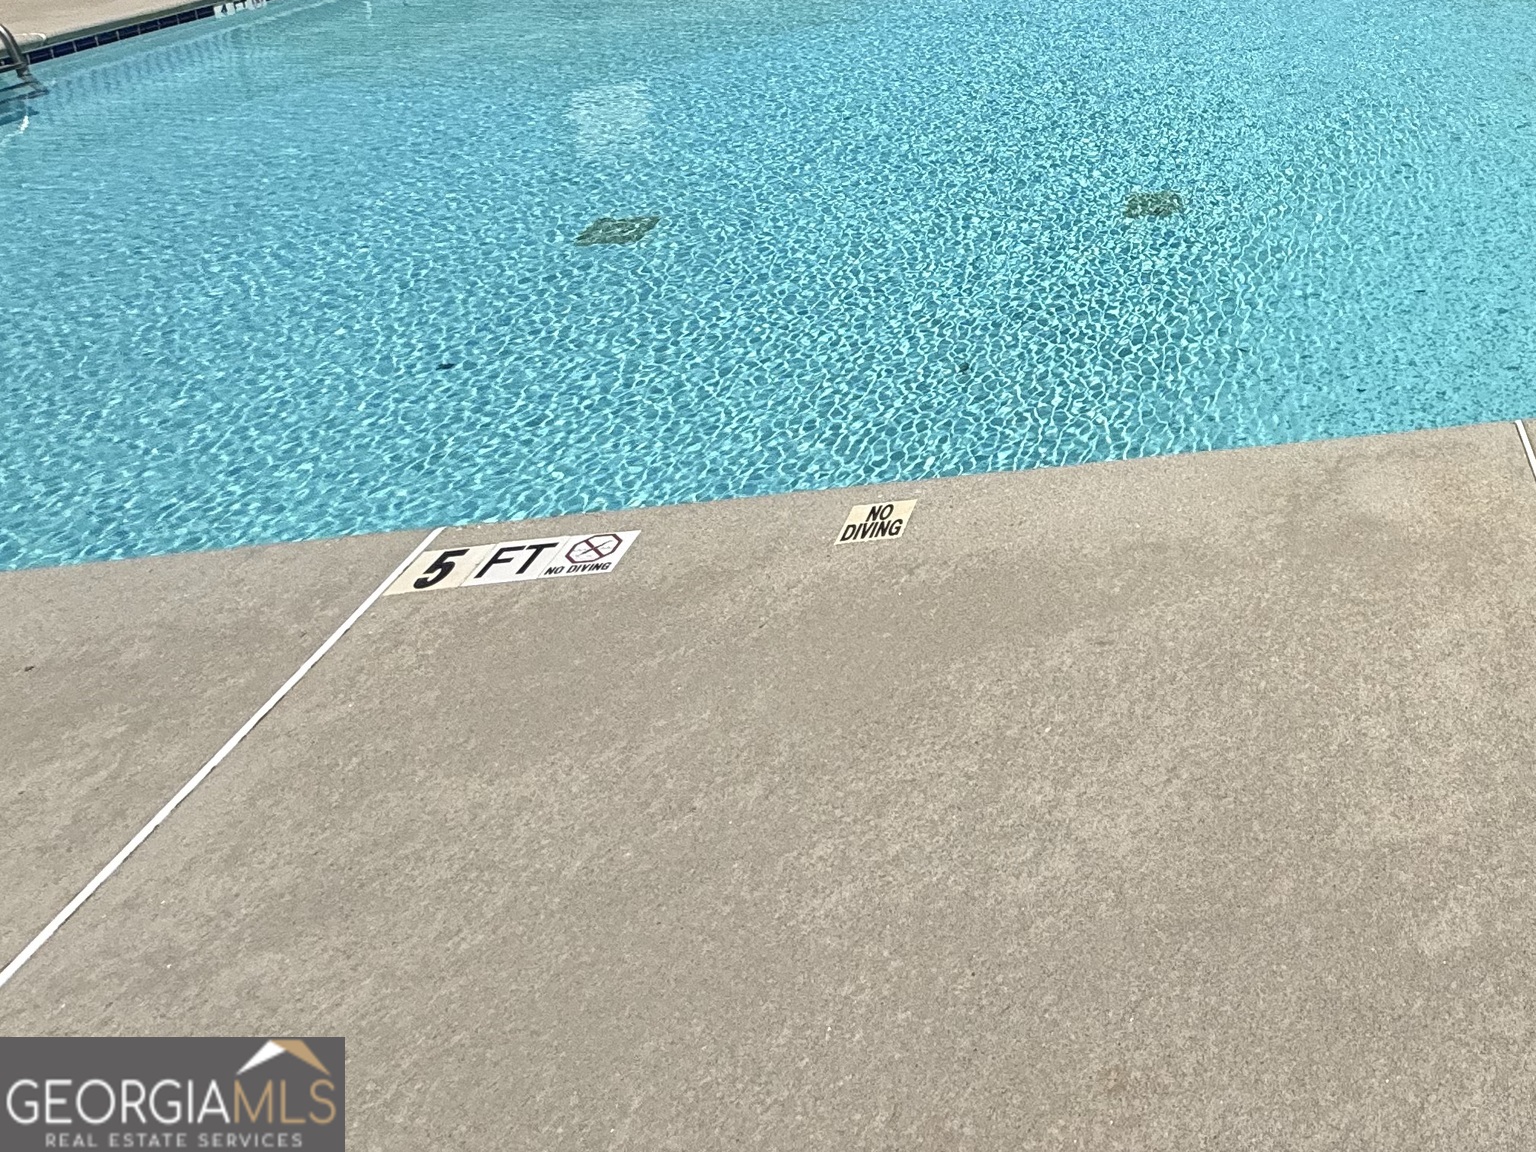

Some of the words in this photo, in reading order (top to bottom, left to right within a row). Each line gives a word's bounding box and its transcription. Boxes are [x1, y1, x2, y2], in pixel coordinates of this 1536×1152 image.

[865, 504, 894, 522] NO
[840, 519, 903, 541] DIVING
[413, 548, 470, 590] 5
[474, 542, 559, 579] FT
[545, 565, 565, 576] NO
[566, 561, 612, 574] DIVING
